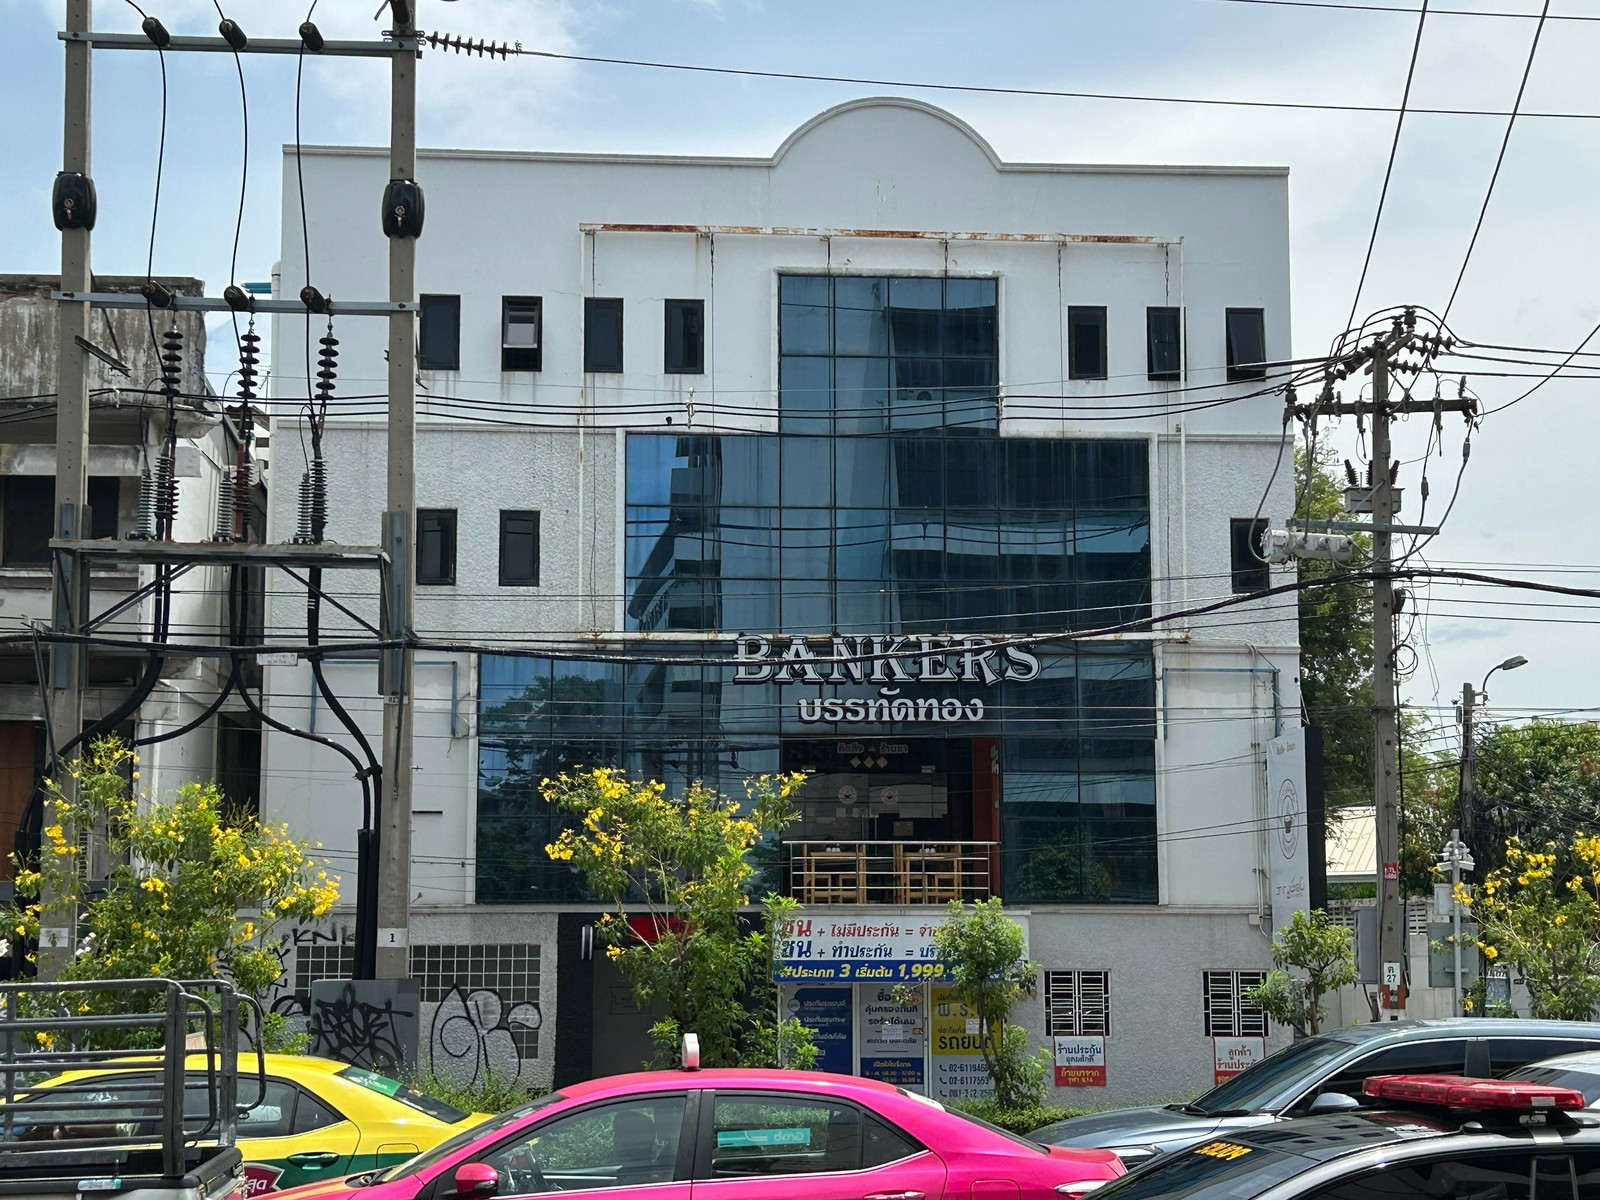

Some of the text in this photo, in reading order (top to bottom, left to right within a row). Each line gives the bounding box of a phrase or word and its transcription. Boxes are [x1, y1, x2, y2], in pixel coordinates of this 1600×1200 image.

[732, 634, 1042, 686] BANKERS
[799, 686, 984, 723] บรรทัดทอง
[831, 923, 899, 937] ไม่มีประกัน
[390, 933, 395, 943] 1
[832, 941, 892, 958] ทำประกัน
[839, 963, 850, 977] 3
[855, 963, 893, 977] เริ่มต้น
[1387, 974, 1397, 982] 27
